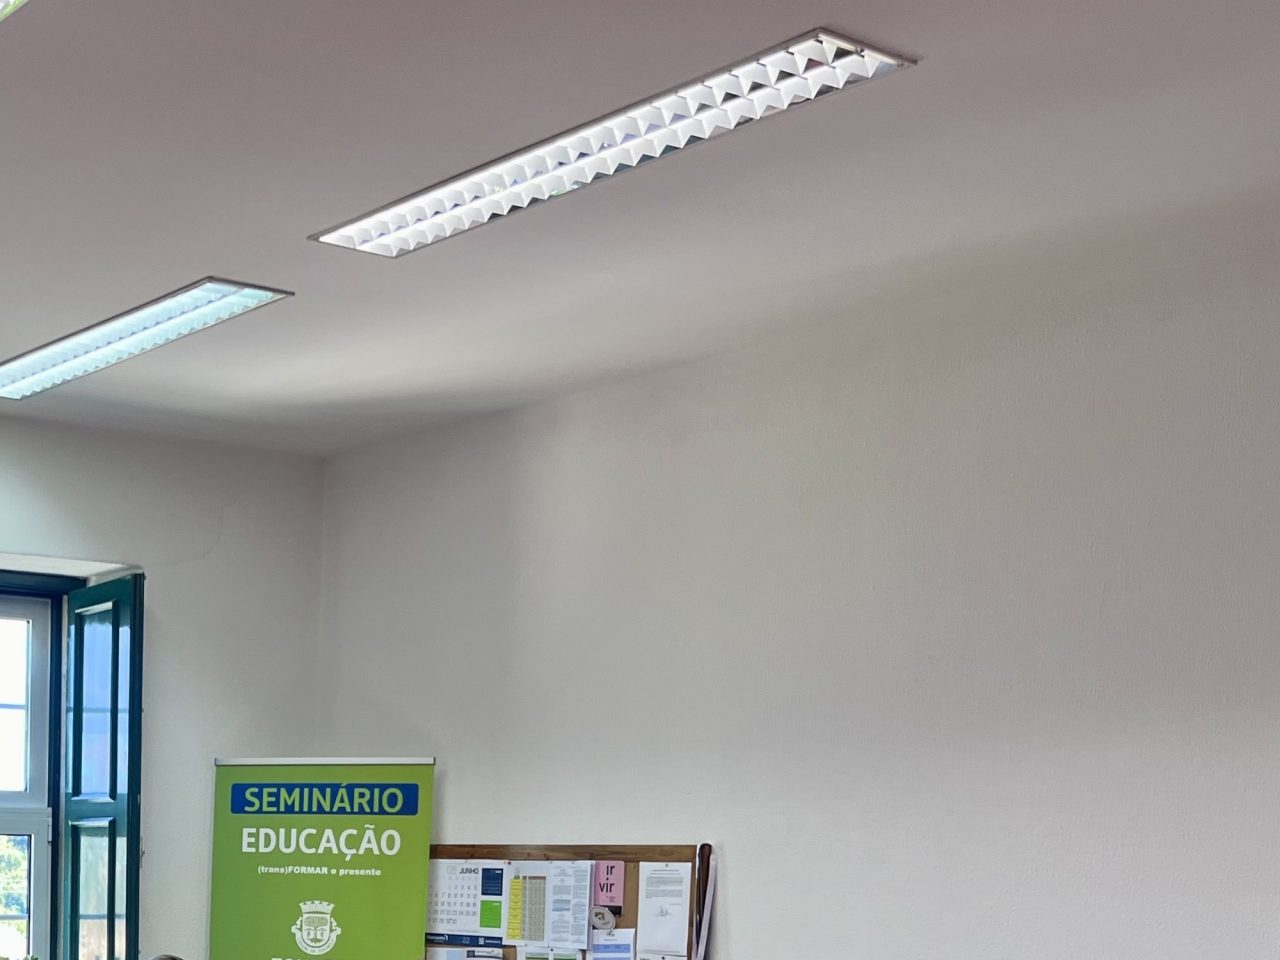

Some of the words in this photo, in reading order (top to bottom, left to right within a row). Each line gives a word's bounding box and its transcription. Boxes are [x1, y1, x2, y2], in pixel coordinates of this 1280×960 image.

[244, 783, 404, 813] SEMINÁRIO
[241, 824, 401, 861] EDUCAÇÃO
[257, 865, 328, 875] (trans)FORMAR
[339, 867, 382, 877] presente
[459, 867, 479, 875] JUNHO
[599, 877, 615, 893] vir
